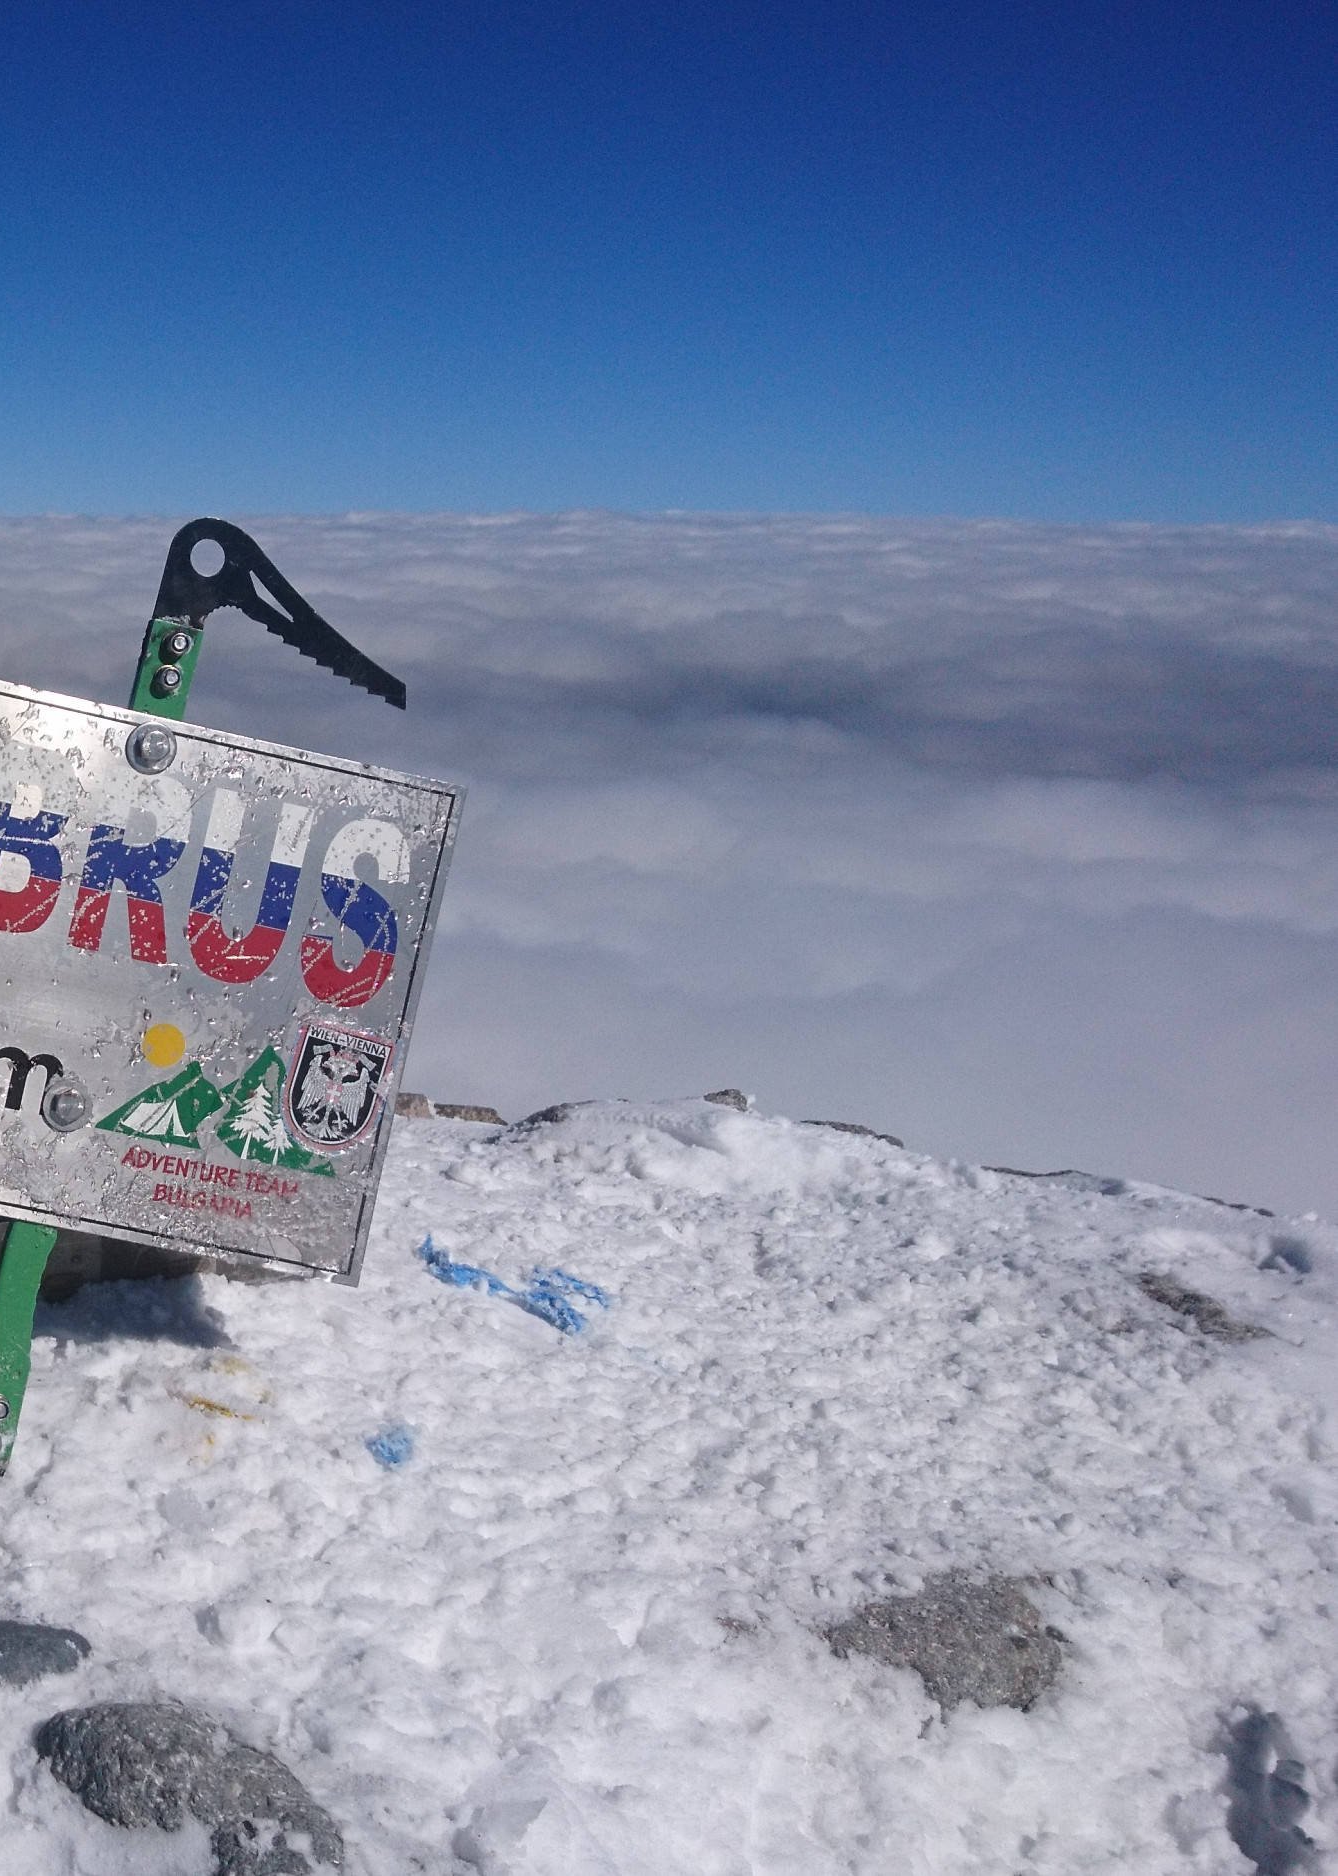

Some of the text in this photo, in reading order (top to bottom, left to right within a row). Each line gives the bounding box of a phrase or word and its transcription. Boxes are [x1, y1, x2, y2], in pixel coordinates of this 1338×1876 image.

[309, 1025, 387, 1058] WIEN-VIENNA
[121, 1144, 299, 1200] ADVENTURE TEAM
